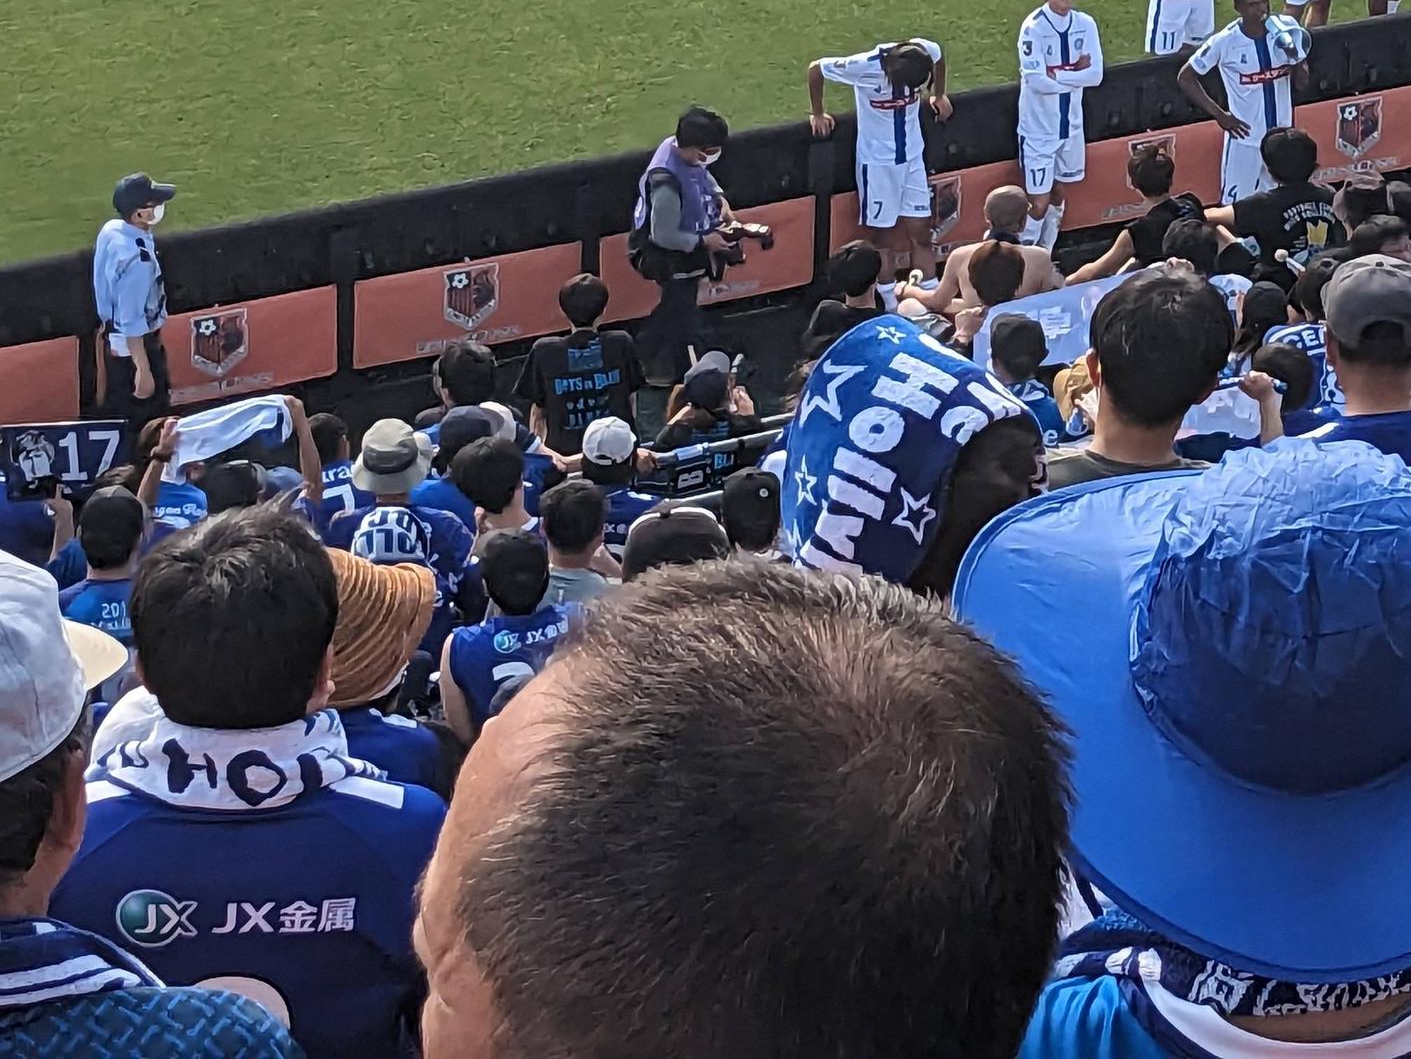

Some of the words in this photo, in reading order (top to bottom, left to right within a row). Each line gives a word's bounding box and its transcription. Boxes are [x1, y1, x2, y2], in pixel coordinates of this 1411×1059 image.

[1162, 31, 1176, 50] 11
[1030, 167, 1046, 187] 17
[872, 200, 883, 220] 7
[58, 429, 120, 482] 17
[211, 897, 356, 935] JX金属
